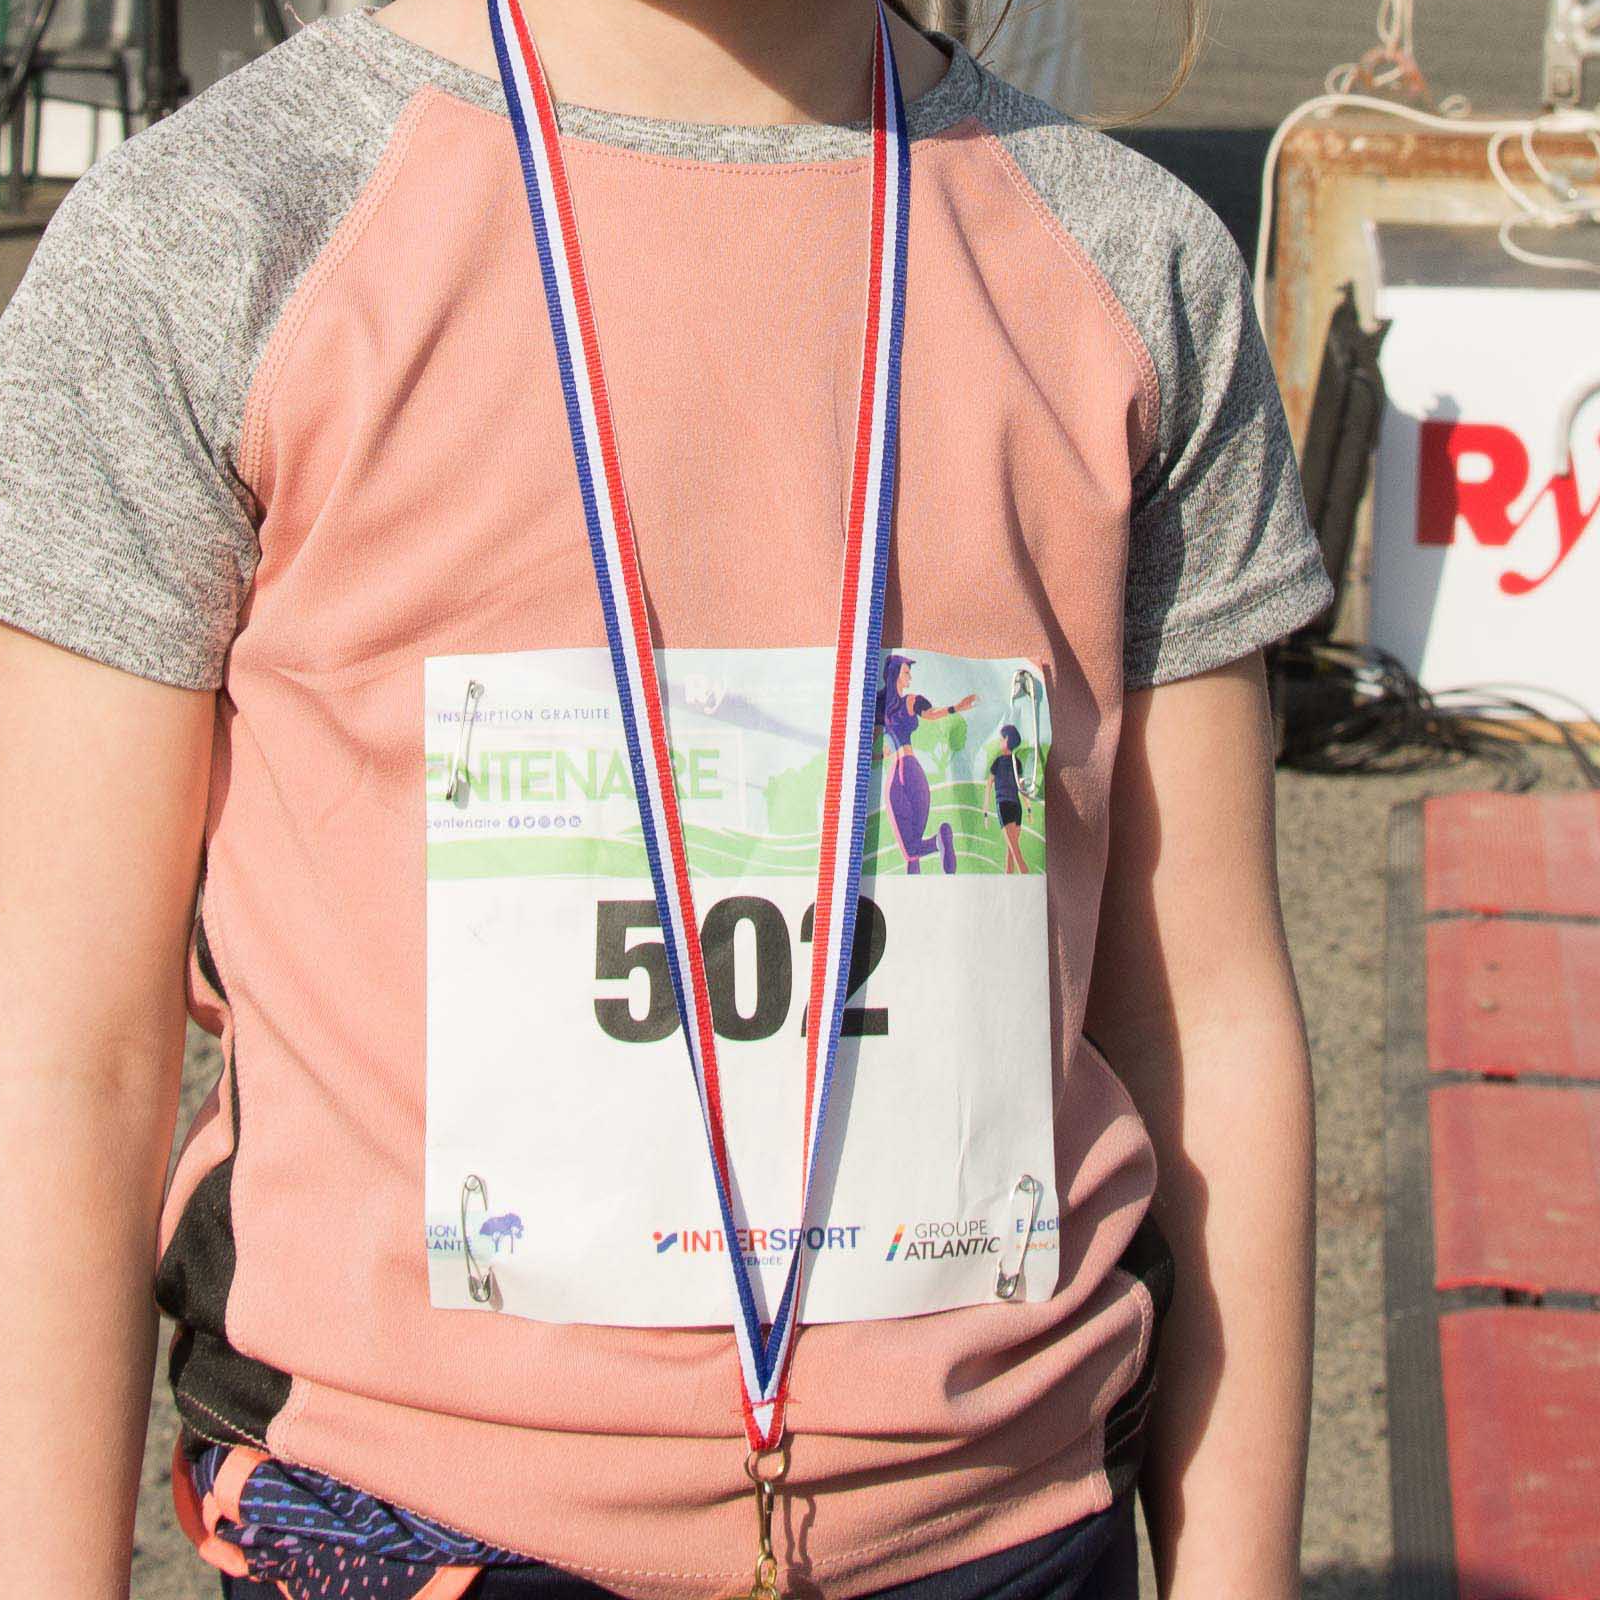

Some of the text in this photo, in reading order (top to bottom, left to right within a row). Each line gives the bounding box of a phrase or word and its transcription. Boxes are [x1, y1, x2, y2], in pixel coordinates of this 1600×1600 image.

[540, 707, 611, 722] GRATUITE
[593, 895, 889, 1043] 502
[914, 1219, 989, 1239] GROUPE
[904, 1236, 1001, 1261] ATLANTIC
